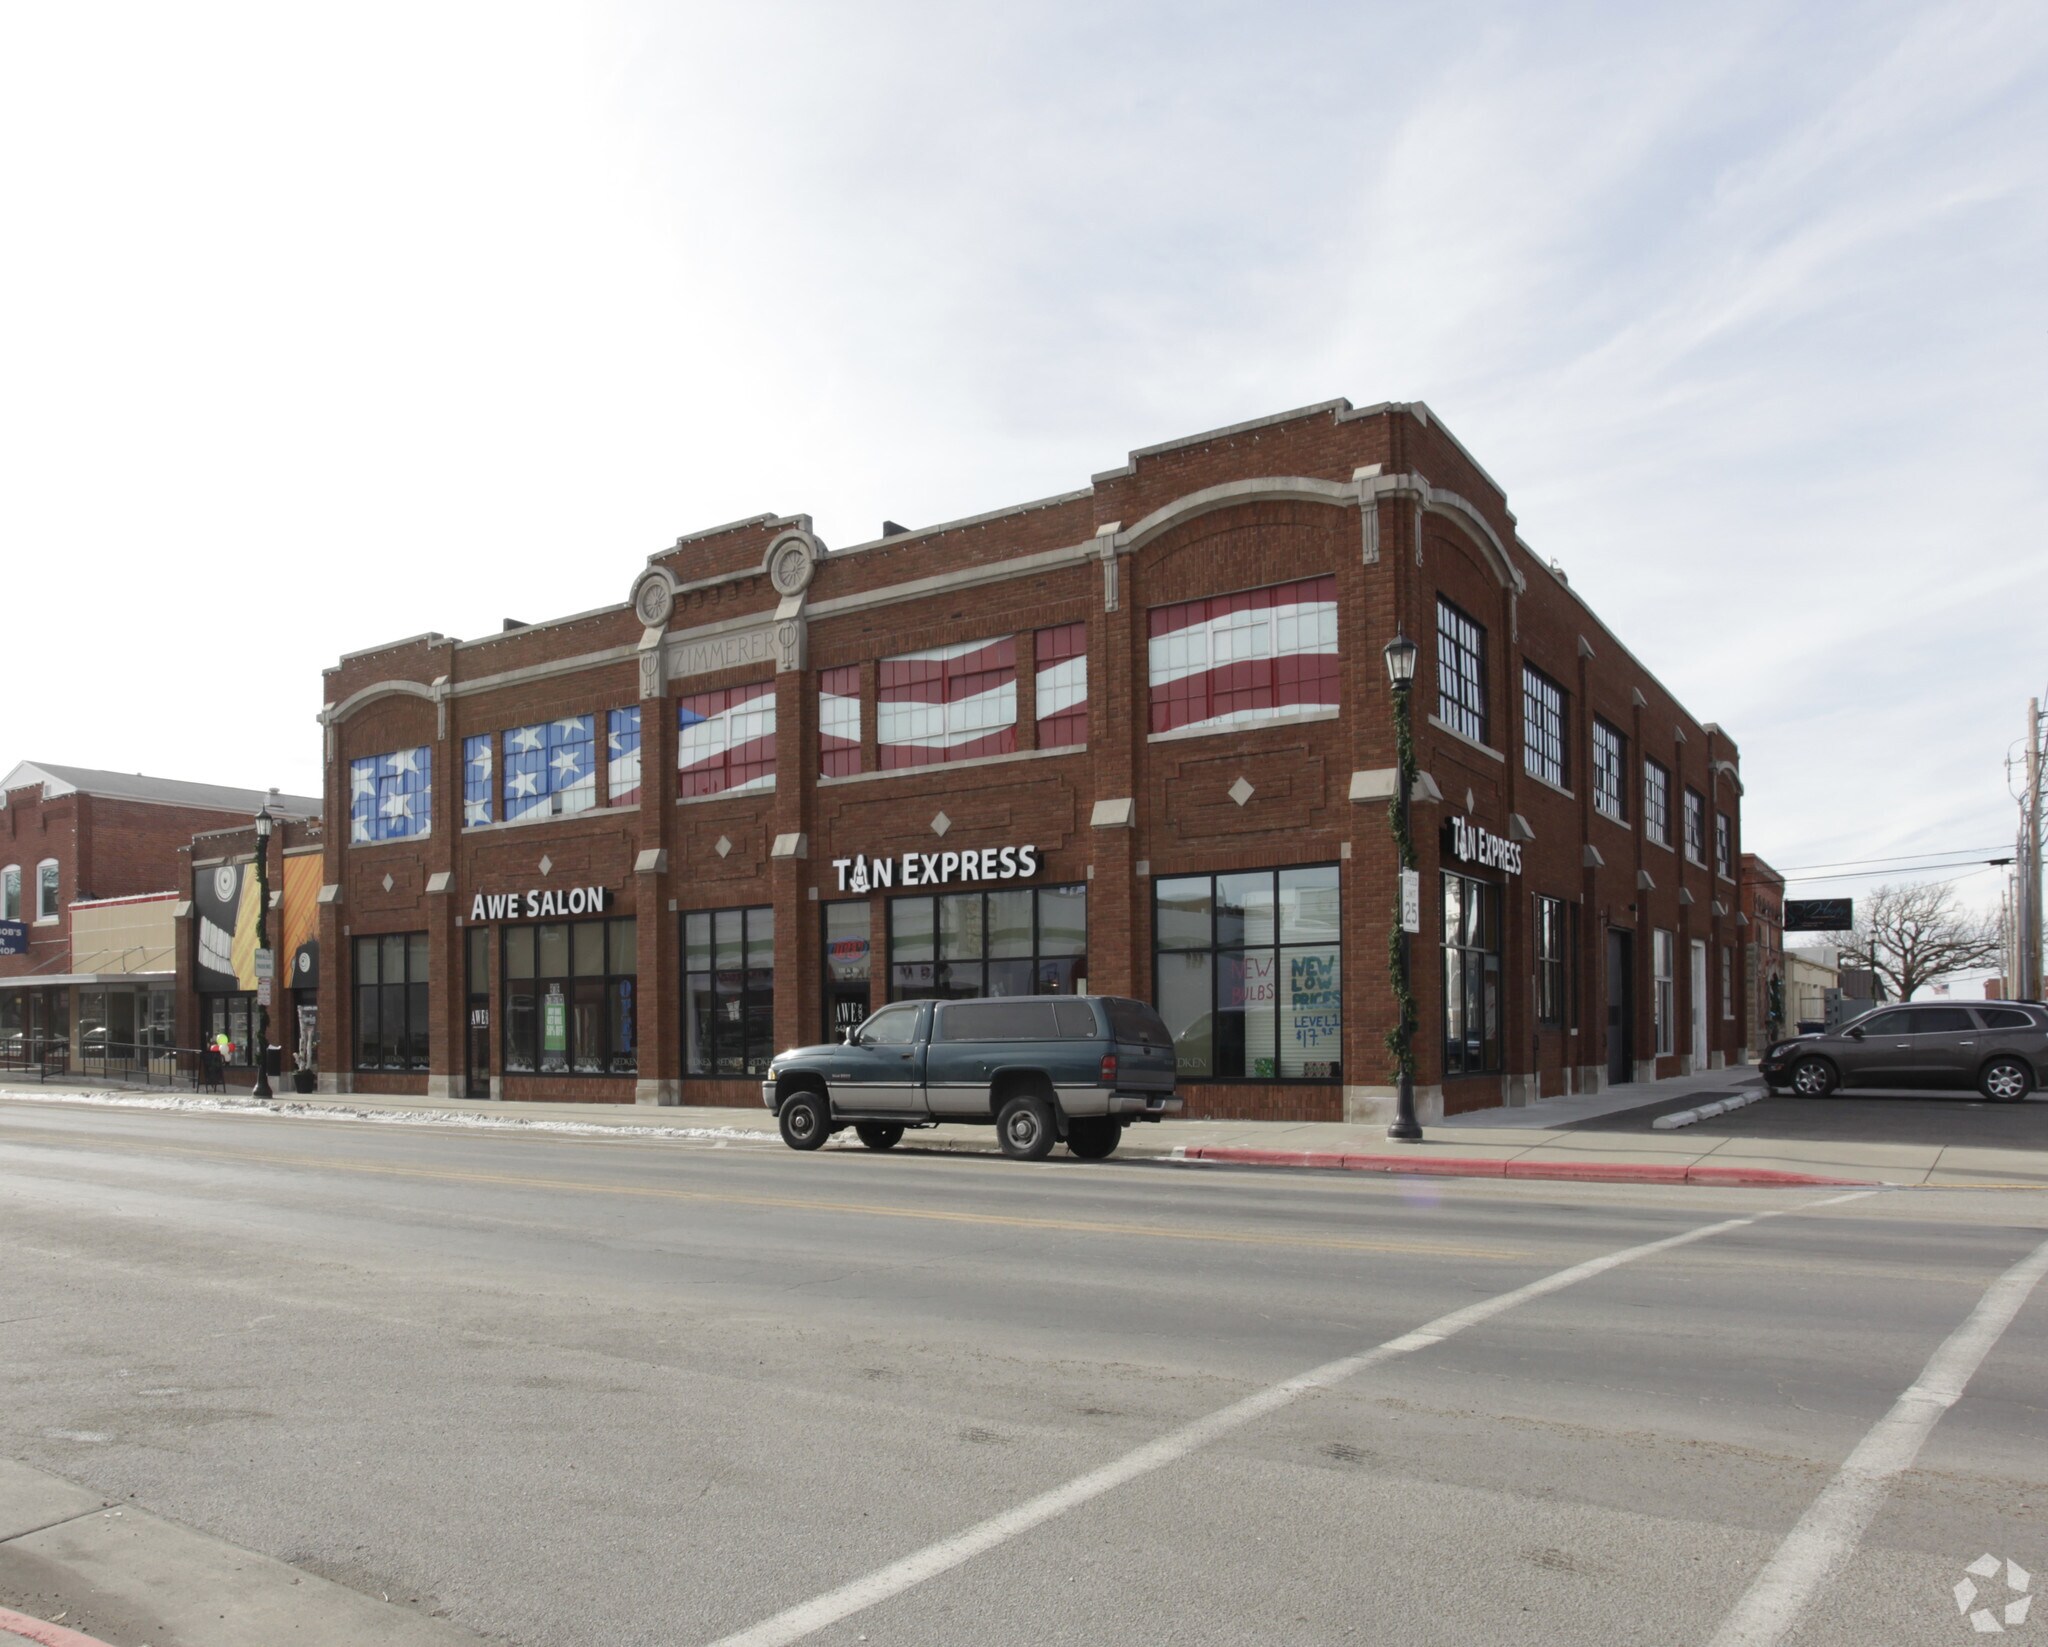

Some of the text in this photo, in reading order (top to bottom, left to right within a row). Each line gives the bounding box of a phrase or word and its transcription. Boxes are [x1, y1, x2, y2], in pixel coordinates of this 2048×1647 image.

[673, 632, 777, 675] ZIMMERER
[1478, 826, 1522, 876] EXPRESS
[902, 845, 1037, 886] EXPRESS
[471, 886, 603, 920] AWE SALON
[1405, 901, 1417, 924] 25
[0, 928, 22, 937] OB'S
[1232, 957, 1273, 979] NEW
[1291, 955, 1334, 977] NEW
[1232, 983, 1274, 1006] BULBS
[1291, 976, 1332, 992] LOW
[835, 1002, 857, 1023] AWE
[748, 1058, 772, 1066] REDKE
[1178, 1058, 1207, 1068] DKEN
